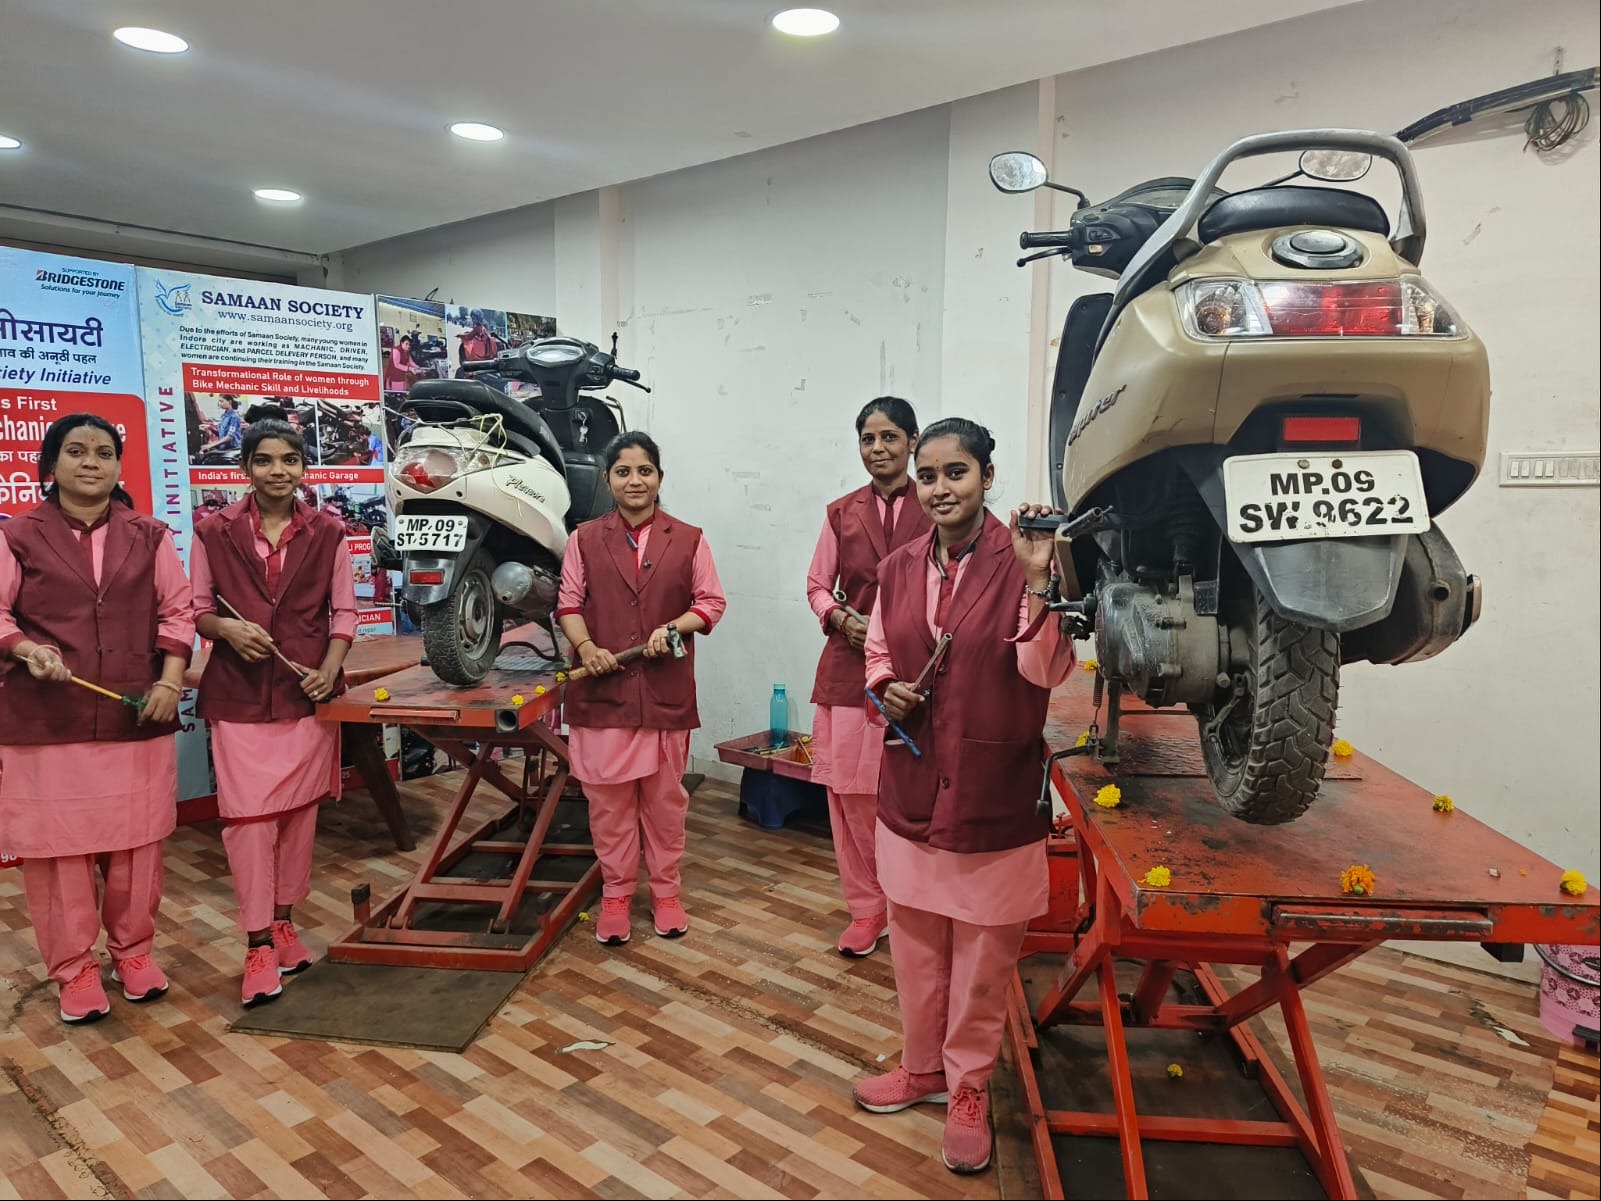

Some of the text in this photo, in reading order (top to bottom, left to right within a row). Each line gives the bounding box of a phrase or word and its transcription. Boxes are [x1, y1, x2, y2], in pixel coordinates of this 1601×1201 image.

[35, 269, 125, 291] BRIDGESTONE
[41, 283, 71, 293] Solutions
[97, 290, 121, 299] journey
[201, 290, 282, 311] SAMAAN
[288, 300, 364, 320] SOCIETY
[217, 310, 353, 333] www.samaansociety.org
[180, 325, 194, 333] Due
[216, 329, 239, 337] efforts
[247, 331, 274, 340] Samaan
[319, 338, 339, 346] young
[180, 334, 207, 343] Indore
[211, 337, 226, 345] city
[247, 341, 278, 349] working
[340, 347, 368, 356] DRIVER,
[247, 347, 274, 356] PARCEL
[275, 350, 309, 358] DELEVERY
[0, 346, 97, 365] ाव की अनूठी पहल
[221, 355, 257, 364] continuing
[274, 358, 299, 366] training
[317, 361, 342, 369] Samaan
[40, 367, 112, 385] Initiative
[191, 367, 270, 380] Transformational
[272, 372, 293, 381] Role
[304, 376, 336, 384] women
[338, 377, 369, 387] through
[192, 379, 349, 396] Bike Mechanic Skill and Livelihoods
[17, 396, 57, 411] First
[17, 450, 41, 464] पह
[159, 386, 181, 515] INITIATIVE
[198, 471, 250, 480] India's firs
[329, 471, 359, 481] Garage
[354, 542, 371, 551] PROG
[359, 613, 381, 623] ICIAN
[180, 687, 196, 733] SAM
